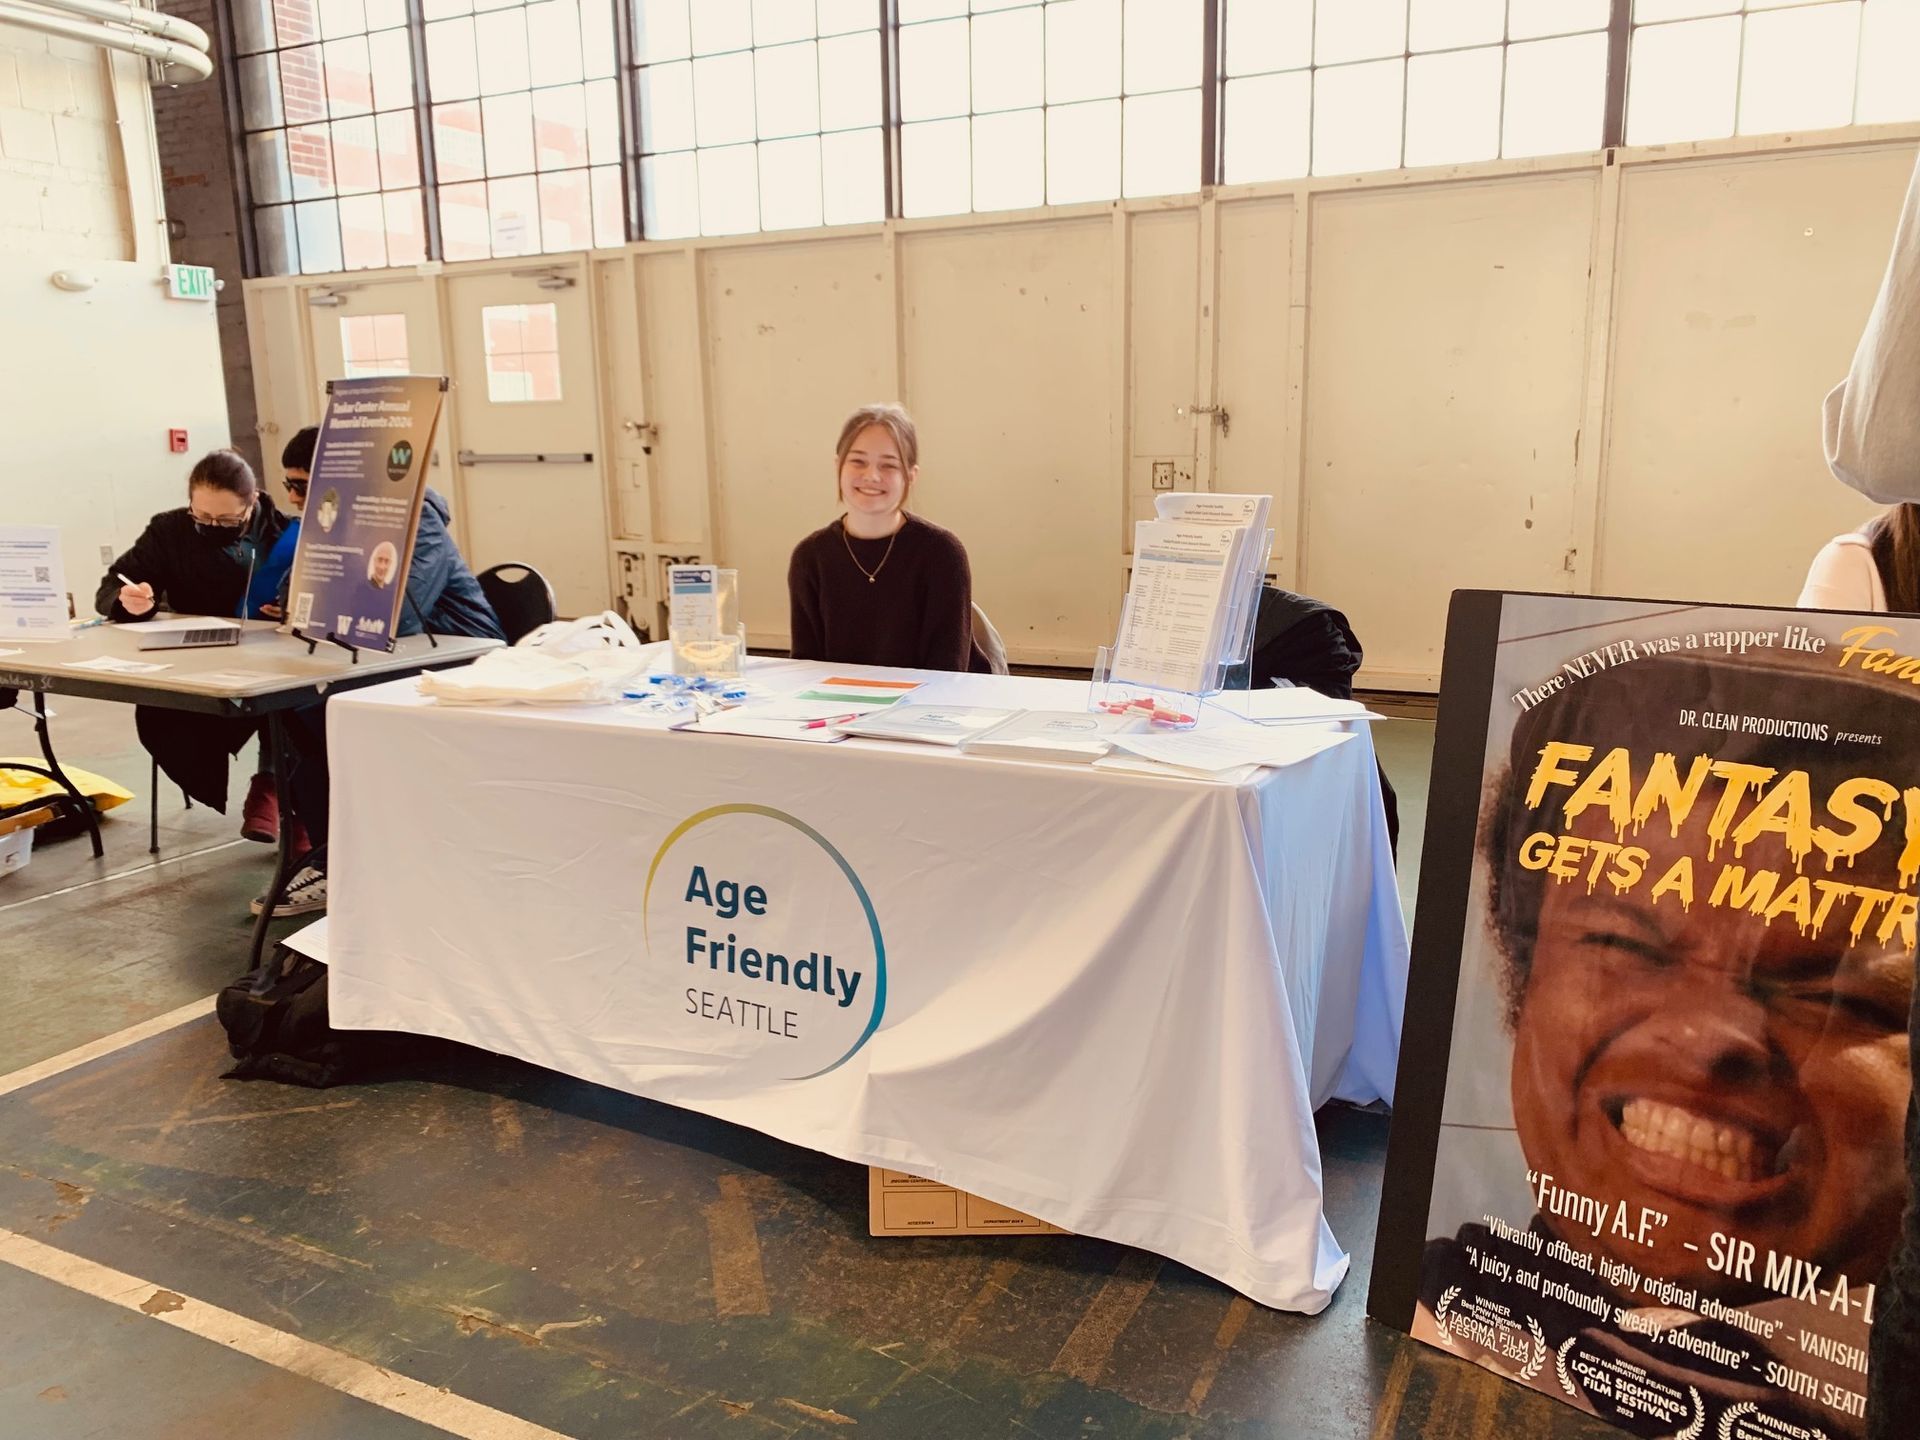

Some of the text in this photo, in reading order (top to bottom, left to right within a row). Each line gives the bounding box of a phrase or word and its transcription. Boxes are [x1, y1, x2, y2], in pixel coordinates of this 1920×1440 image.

[177, 267, 208, 296] EXIT
[1511, 625, 1920, 712] There NEVER was a rapper like Fan
[1679, 709, 1882, 745] DR. CLEAN PRODUCTIONS presents
[684, 865, 768, 919] Age
[1518, 831, 1650, 896] GETS
[1651, 855, 1694, 914] A
[686, 926, 862, 1008] Friendly
[685, 987, 799, 1039] SEATTLE
[1525, 1169, 1609, 1237] “Funny
[1706, 1231, 1756, 1283] SIR
[1483, 1213, 1543, 1256] “Vibrantly
[1546, 1240, 1596, 1276] offbeat,
[1599, 1255, 1641, 1294] highly
[1643, 1276, 1697, 1311] original
[1700, 1298, 1783, 1340] adventure”
[1460, 1299, 1475, 1312] Best
[1492, 1312, 1522, 1330] Narrative
[1471, 1311, 1511, 1333] Feature Film
[1475, 1295, 1511, 1317] WINNER
[1479, 1251, 1512, 1283] juicy,
[1516, 1268, 1540, 1291] and
[1542, 1279, 1611, 1323] profoundly
[1613, 1306, 1664, 1344] sweaty,
[1667, 1327, 1749, 1371] adventure”
[1765, 1360, 1819, 1401] SOUTH
[1449, 1310, 1529, 1353] TACOMA FILM
[1449, 1321, 1529, 1364] FESTIVAL 2023
[1571, 1359, 1688, 1417] LOCAL SIGHTINGS
[1579, 1351, 1683, 1400] BEST NARRATIVE FEATURE
[1615, 1358, 1647, 1376] WINNER
[1583, 1376, 1673, 1424] FILM FESTIVAL
[1616, 1405, 1635, 1419] 2023
[1739, 1419, 1763, 1433] Seattle
[1757, 1412, 1811, 1440] WINNER
